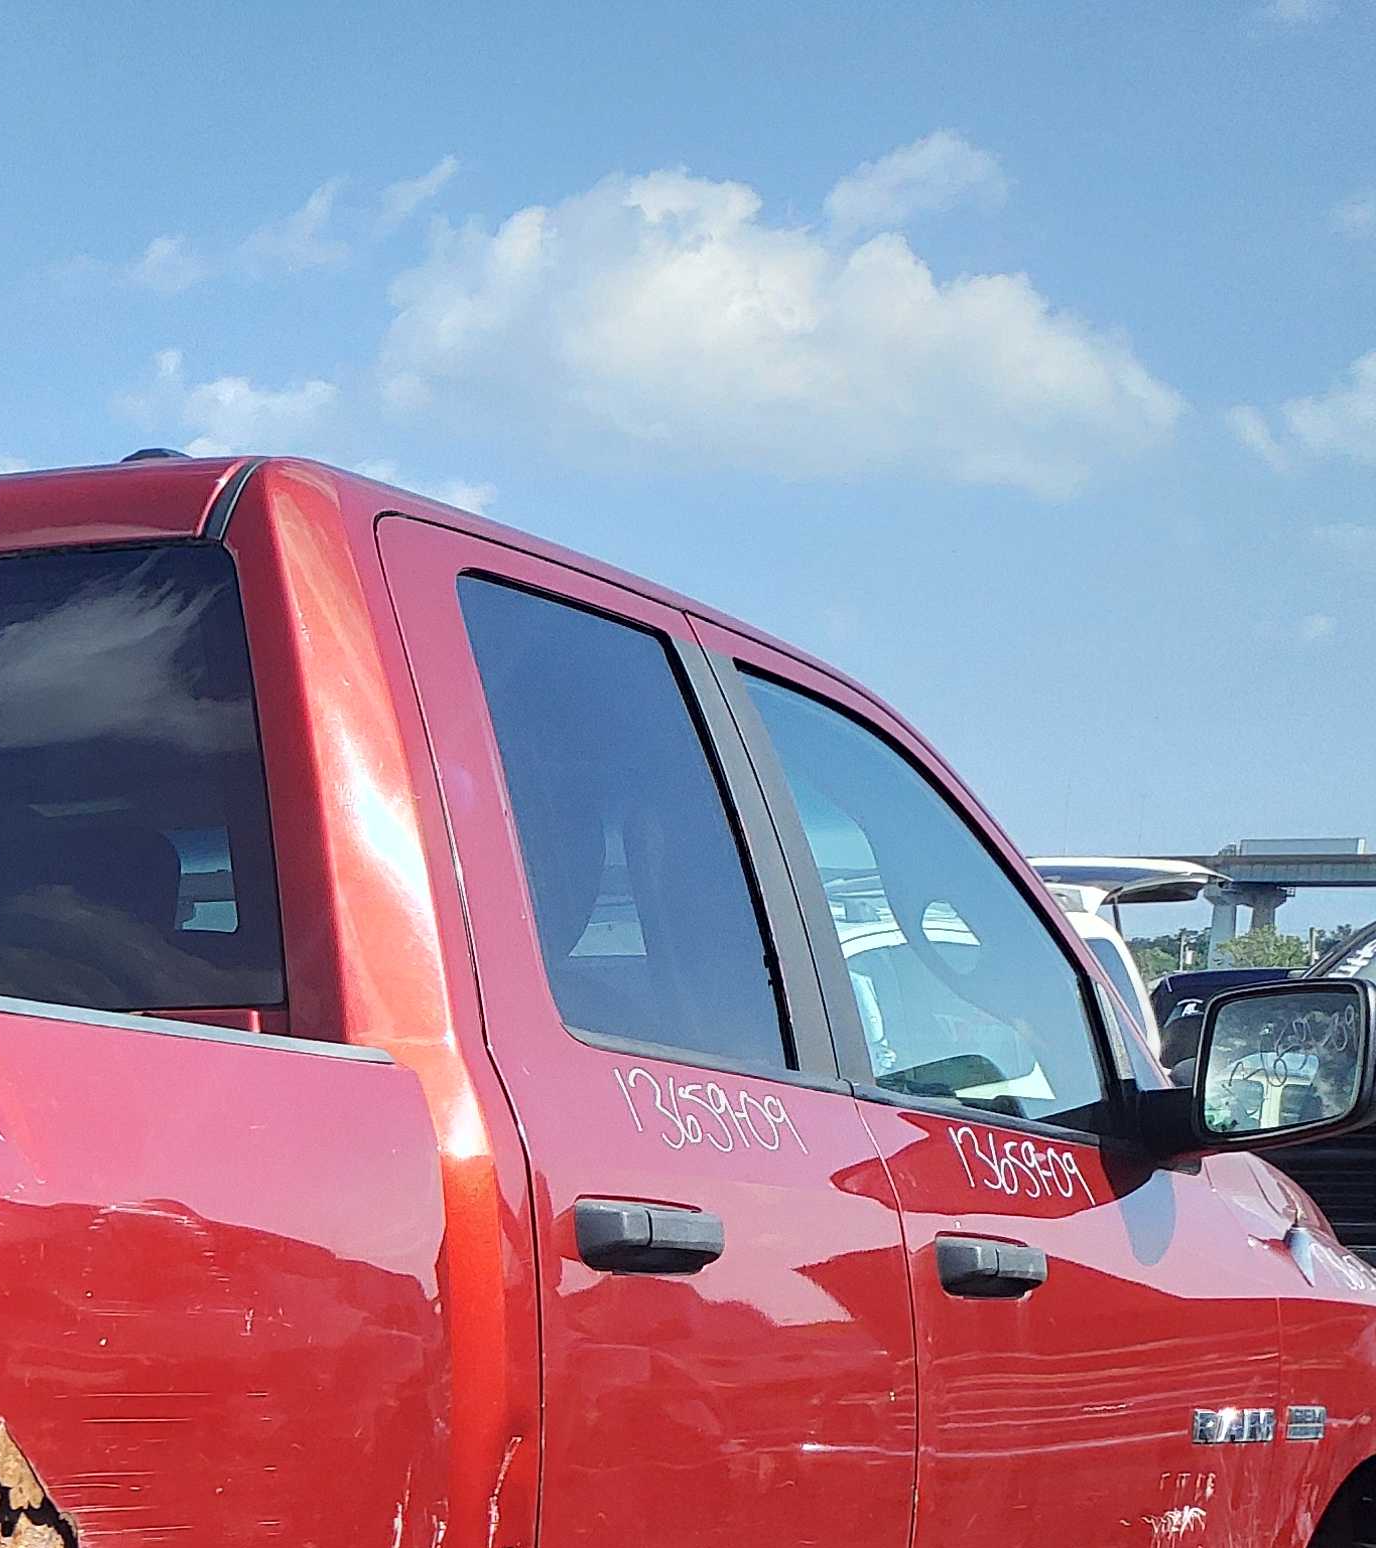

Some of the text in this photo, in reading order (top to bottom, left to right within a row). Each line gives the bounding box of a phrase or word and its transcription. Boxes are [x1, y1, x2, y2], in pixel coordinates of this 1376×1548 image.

[613, 1066, 809, 1155] 13659-09
[948, 1124, 1097, 1207] 13659-09
[1192, 1407, 1277, 1444] RAM
